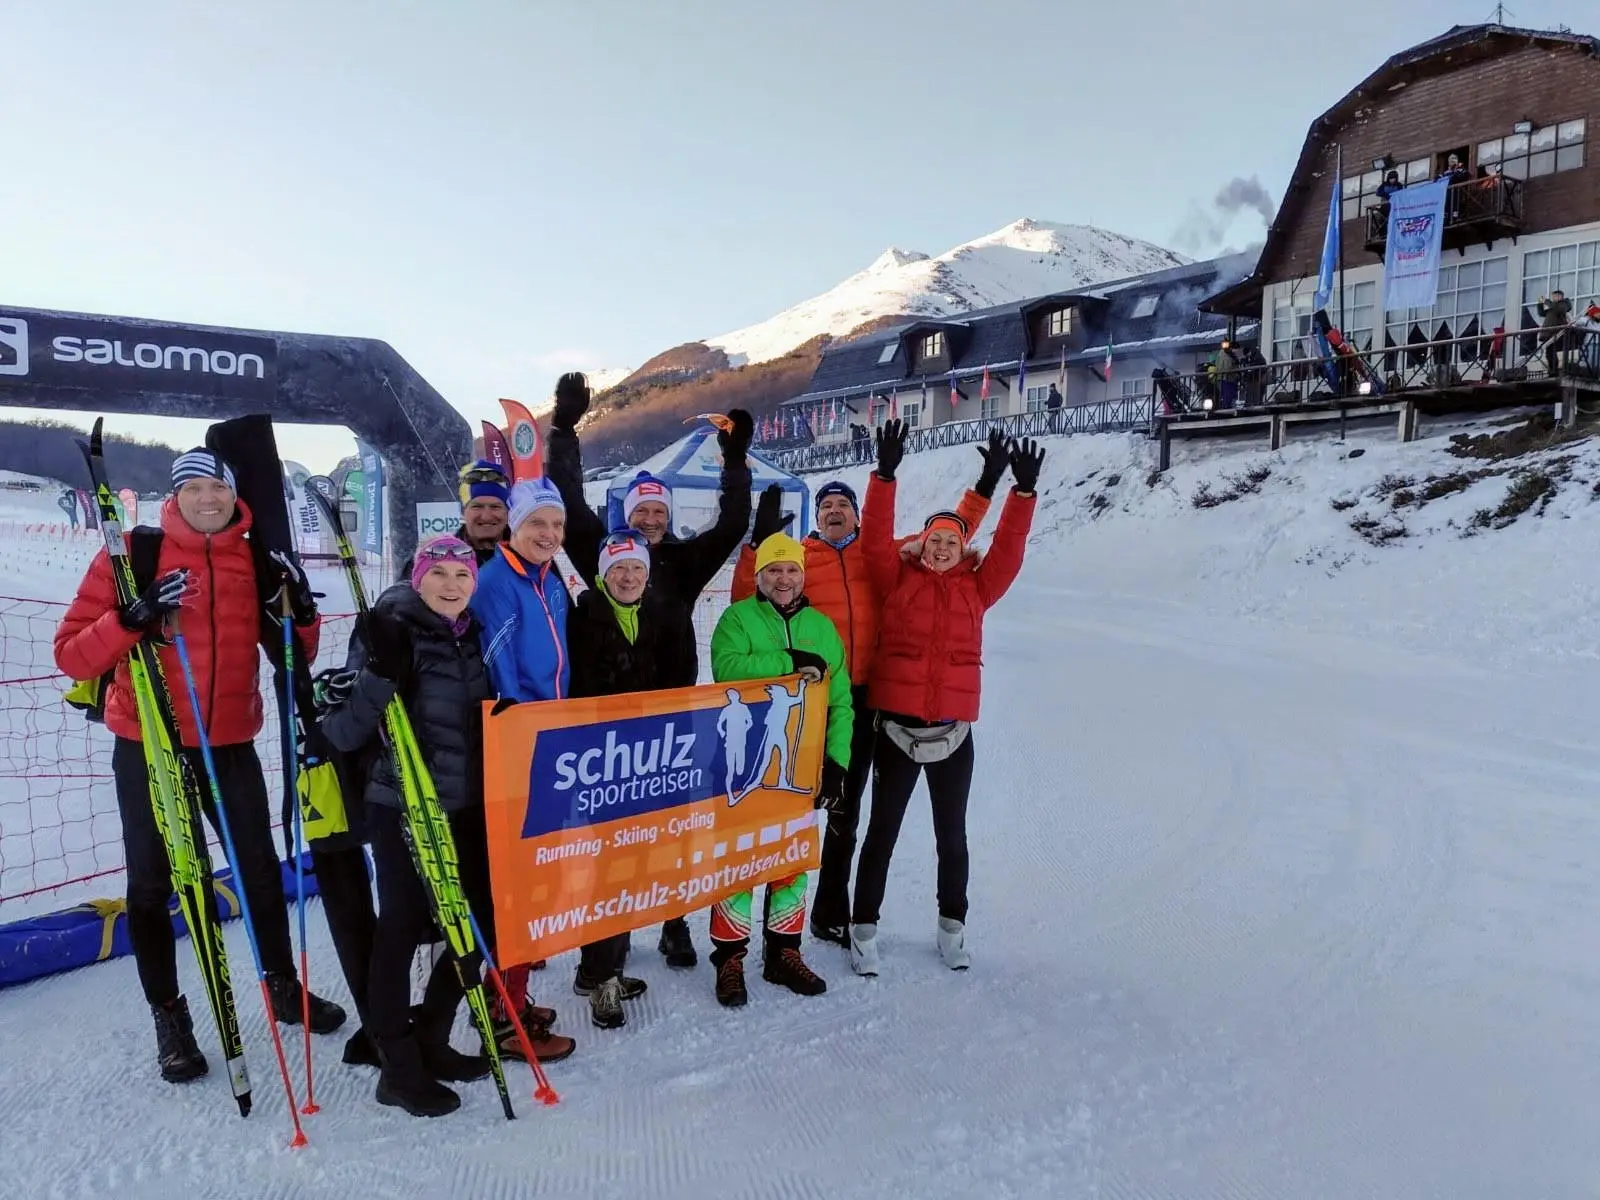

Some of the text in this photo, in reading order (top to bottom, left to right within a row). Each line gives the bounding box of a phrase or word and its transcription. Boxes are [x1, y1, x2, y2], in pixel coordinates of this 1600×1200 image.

[554, 722, 697, 790] schulz
[164, 749, 199, 882] FISCHER
[577, 767, 702, 815] sportreisen
[536, 811, 716, 866] Running Skiing Cycling
[528, 838, 810, 941] www.schulz-sportreisen.de
